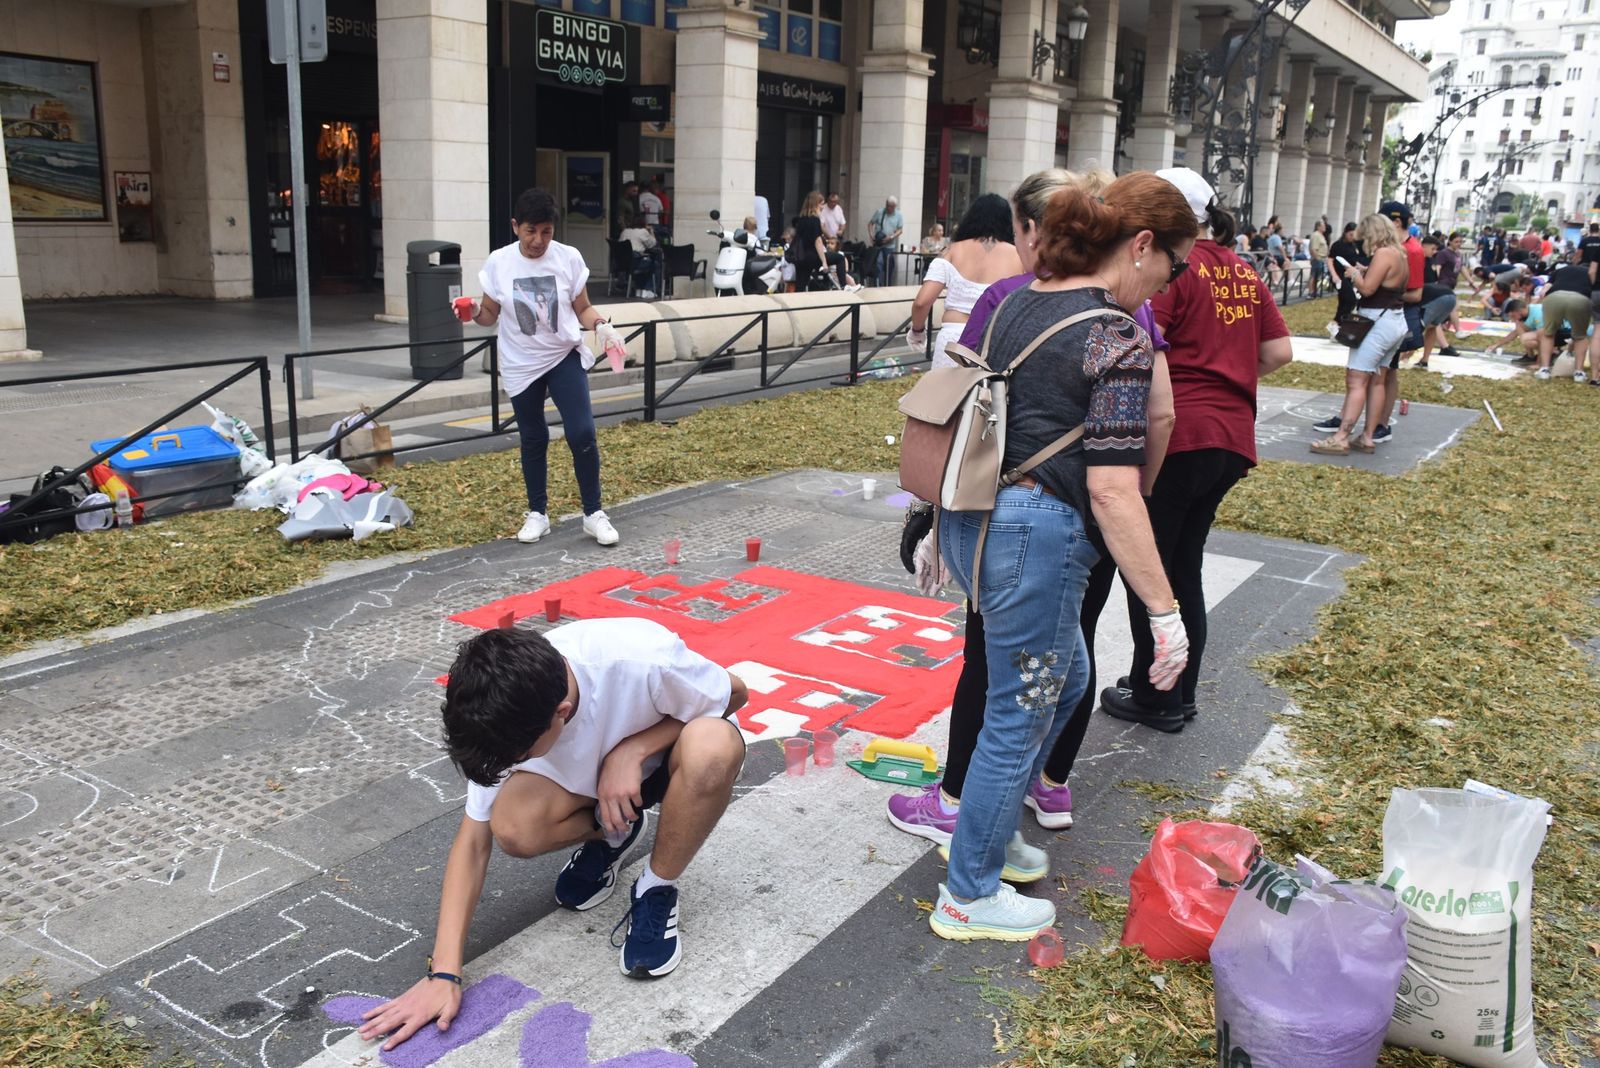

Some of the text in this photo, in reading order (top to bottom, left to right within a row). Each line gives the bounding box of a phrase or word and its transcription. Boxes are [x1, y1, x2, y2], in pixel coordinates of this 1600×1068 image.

[327, 16, 377, 39] ESPENS
[553, 15, 610, 43] BINGO
[539, 39, 623, 69] GRAN VIA
[759, 82, 780, 96] AJES
[941, 903, 970, 924] HOKA
